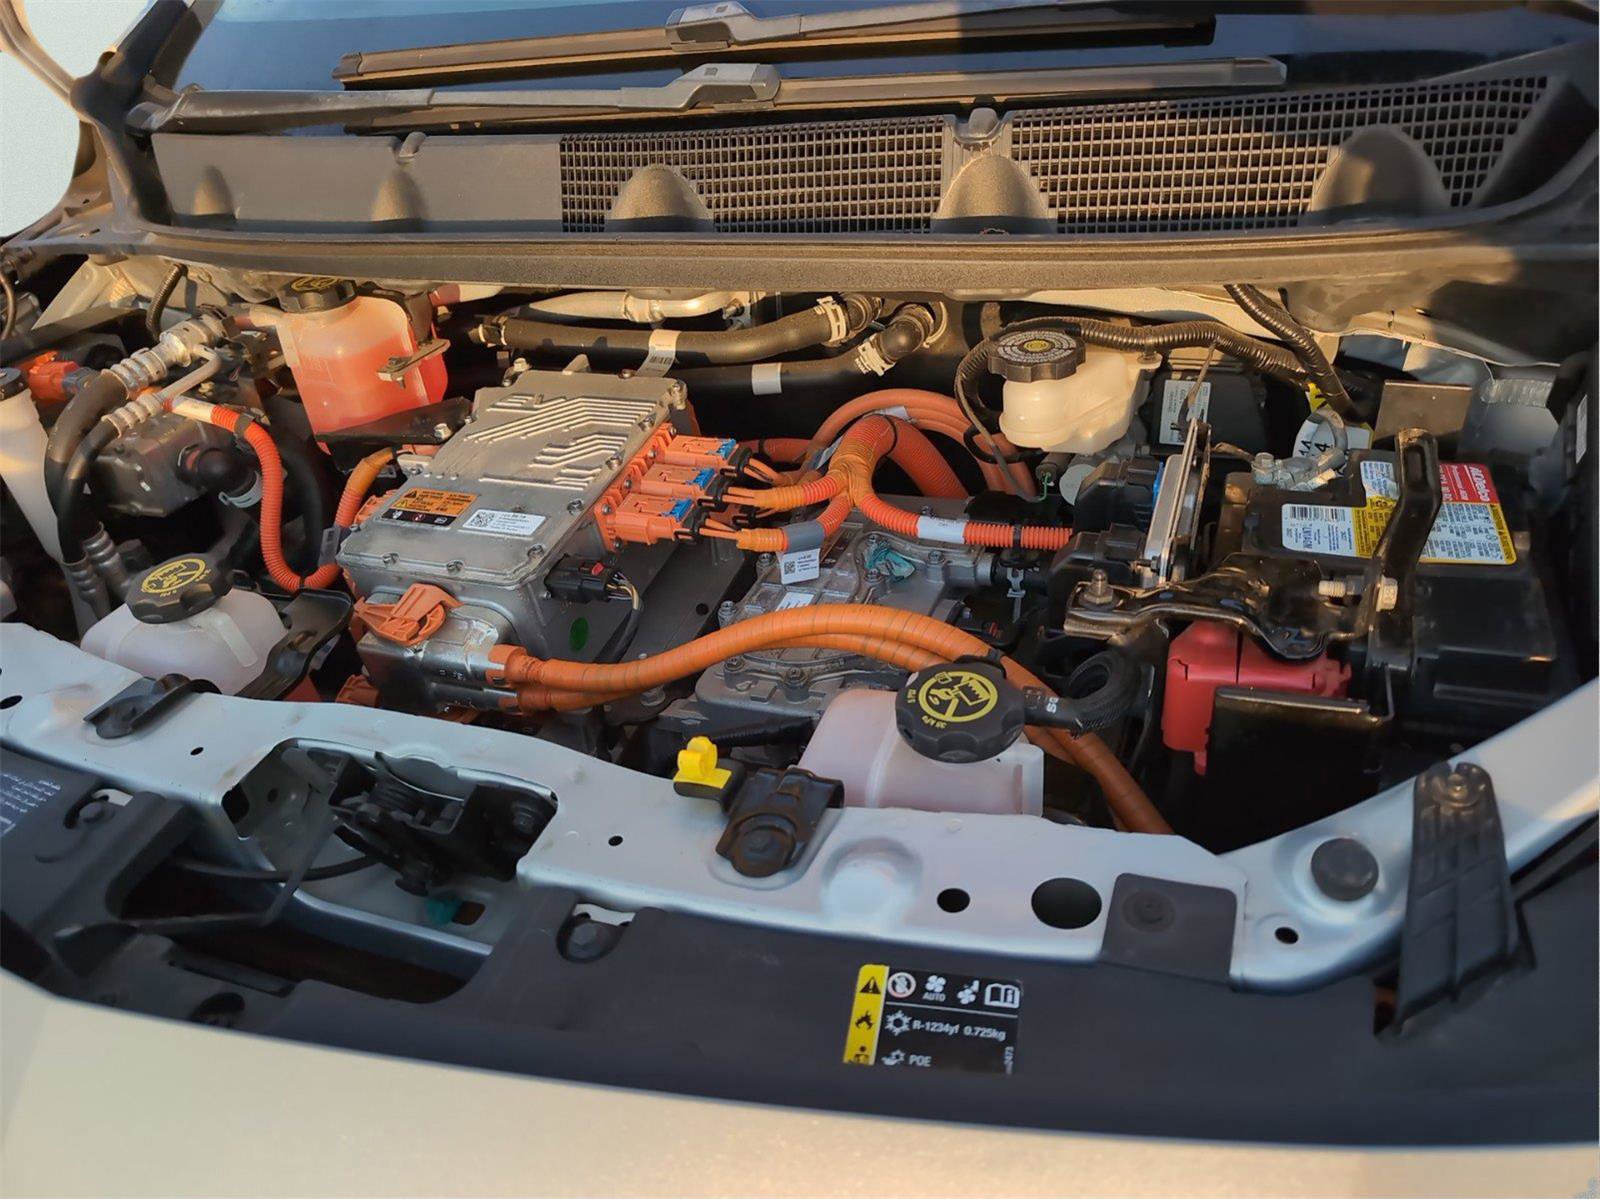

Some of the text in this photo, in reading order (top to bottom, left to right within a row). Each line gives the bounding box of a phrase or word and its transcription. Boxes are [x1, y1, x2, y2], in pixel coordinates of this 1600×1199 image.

[922, 992, 946, 1002] AUTO
[912, 1020, 1007, 1042] R-1234yf 0.725kg
[909, 1054, 931, 1068] POE
